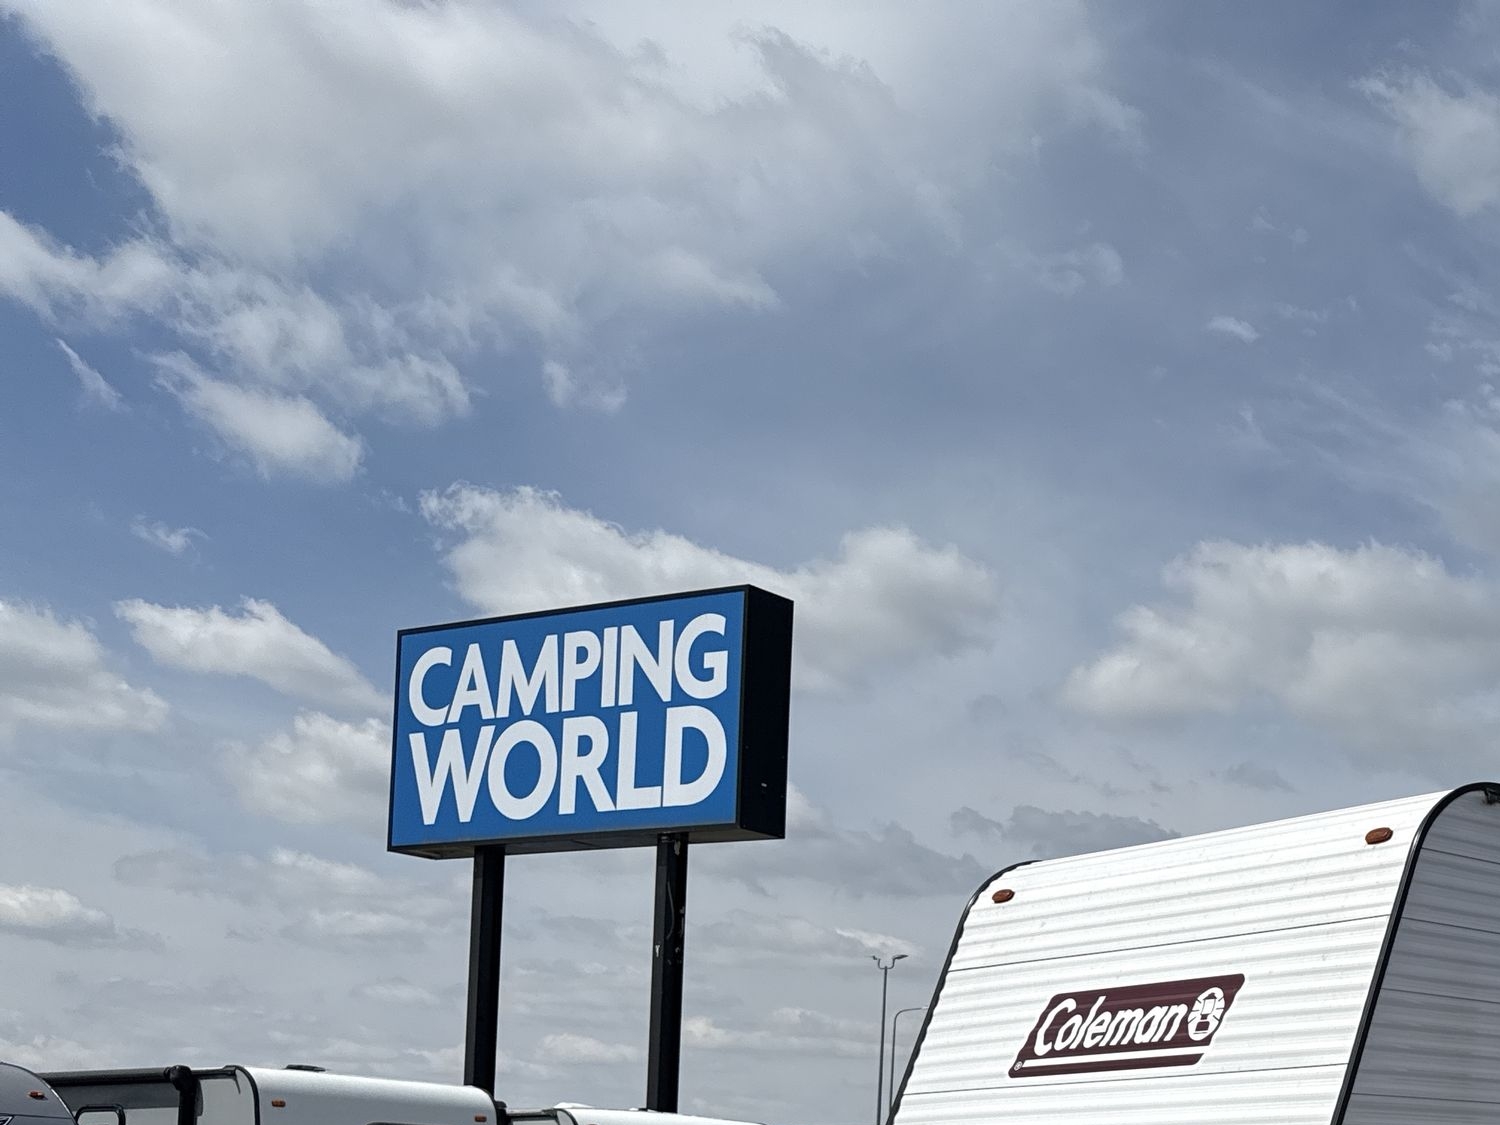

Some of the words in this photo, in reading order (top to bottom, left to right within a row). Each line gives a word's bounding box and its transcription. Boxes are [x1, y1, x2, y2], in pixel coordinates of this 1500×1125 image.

[409, 613, 728, 726] CAMPING
[409, 705, 727, 825] WORLD
[1034, 995, 1188, 1056] Coleman
